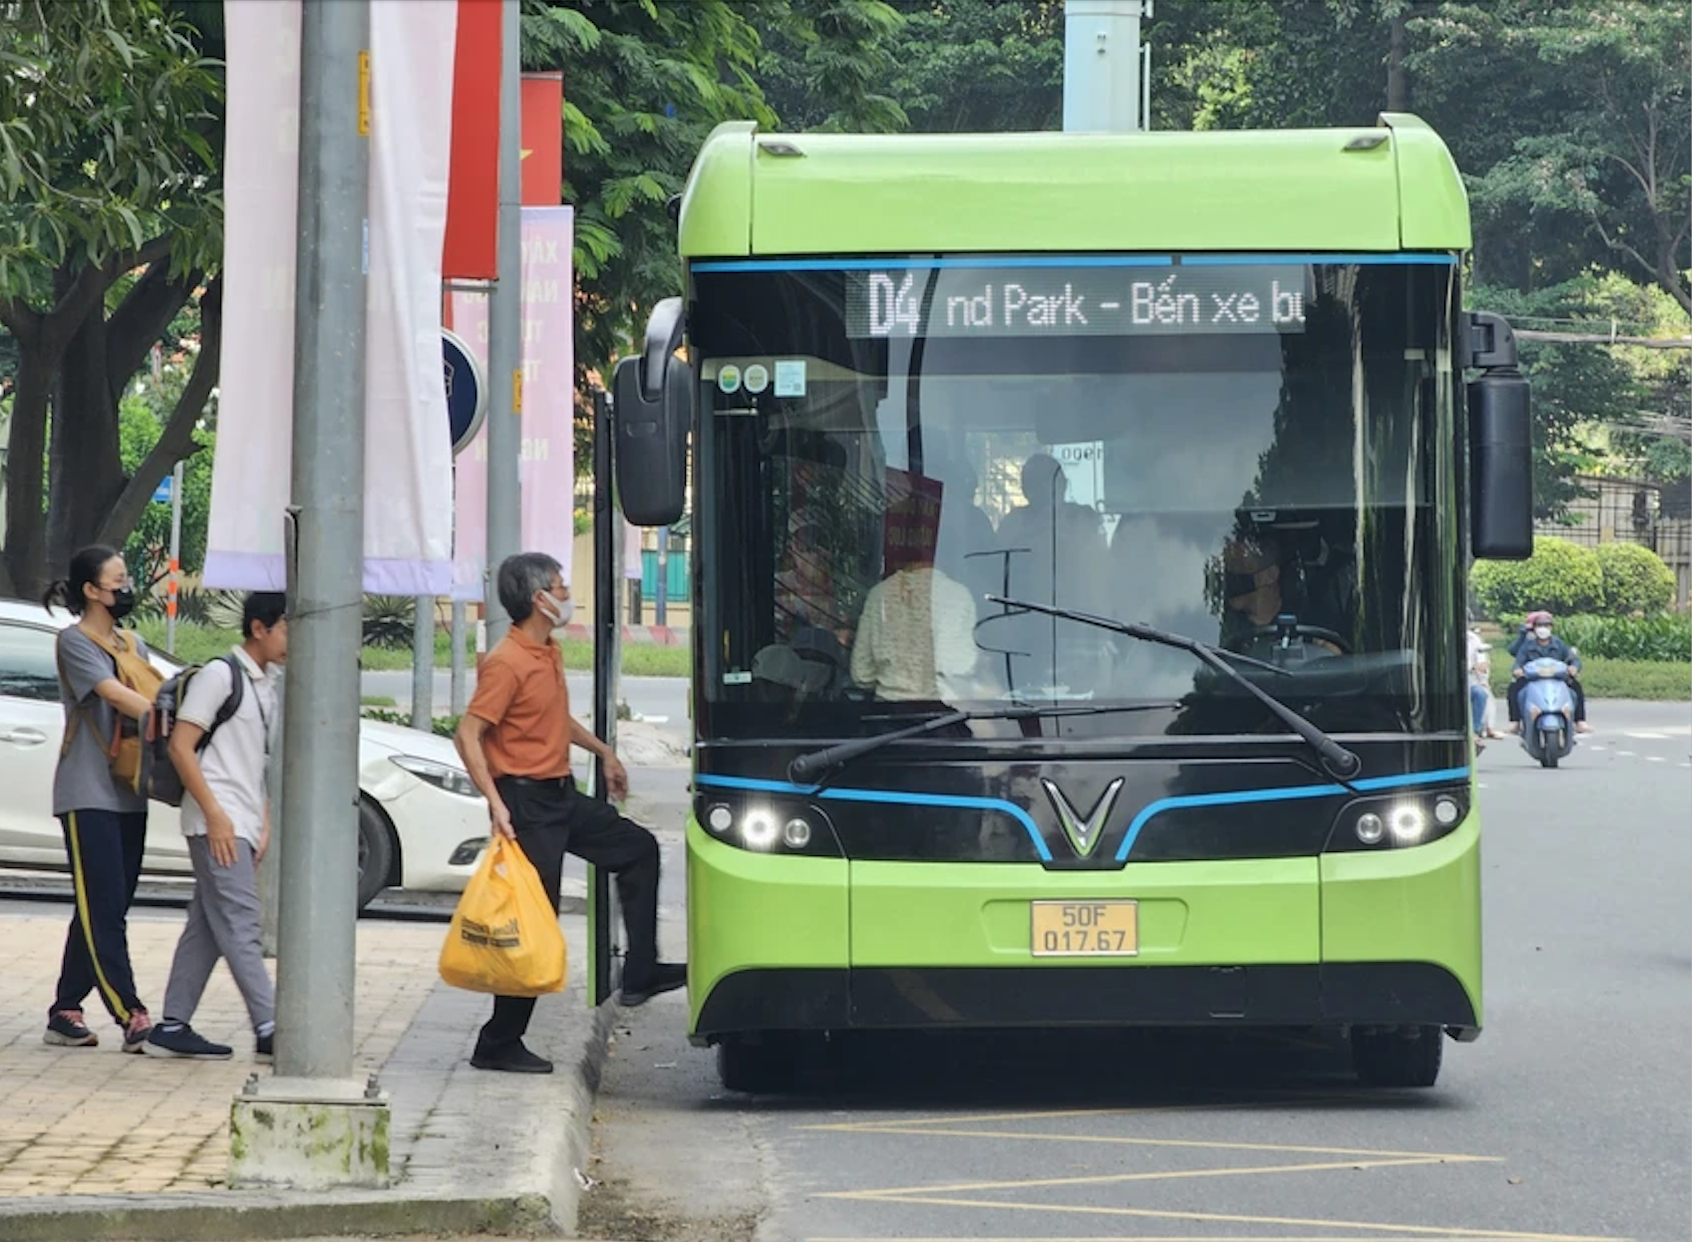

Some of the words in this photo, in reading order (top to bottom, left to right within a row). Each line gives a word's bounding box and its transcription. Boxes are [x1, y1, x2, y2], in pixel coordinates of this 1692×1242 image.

[869, 273, 920, 334] D4
[947, 284, 992, 326] nd
[1004, 282, 1088, 326] Park
[1131, 273, 1199, 324] Bến
[1211, 292, 1260, 323] xe
[1062, 904, 1107, 927] 50F
[1044, 930, 1126, 952] 017.67
